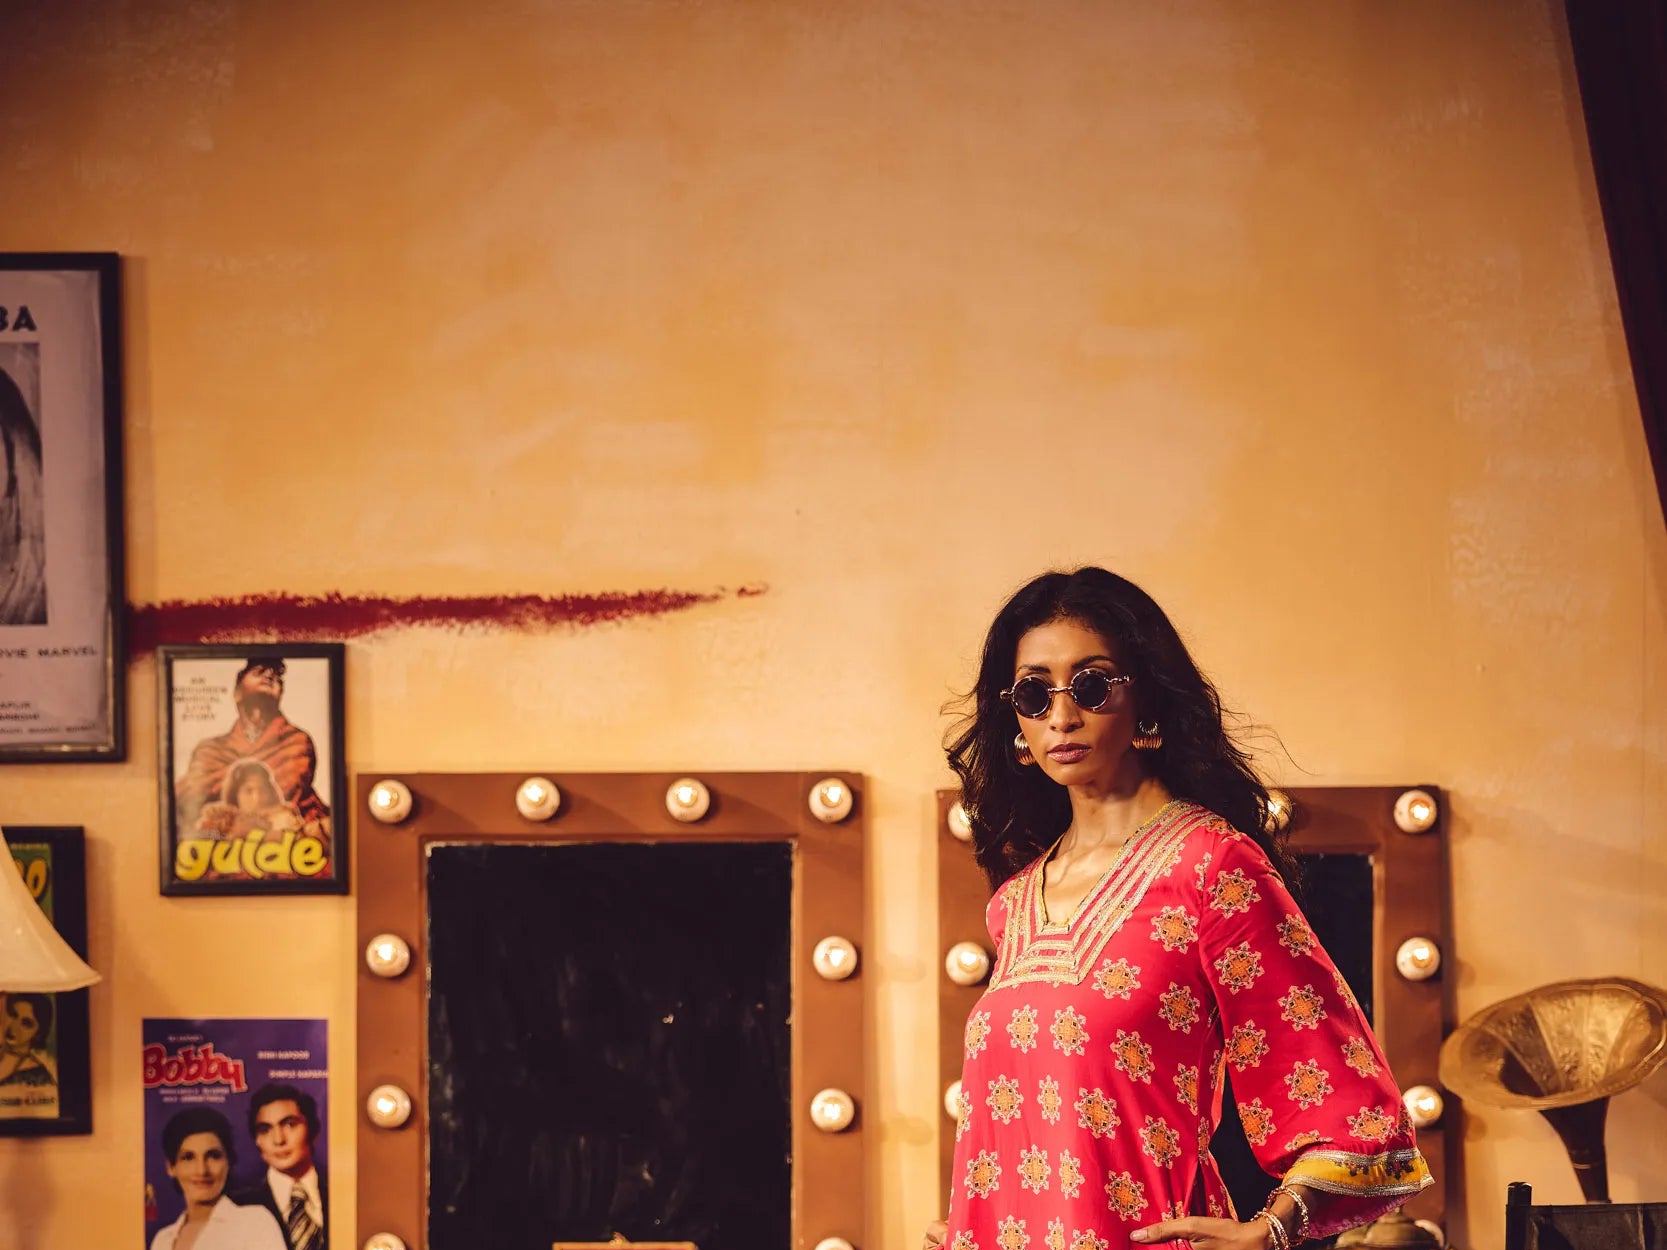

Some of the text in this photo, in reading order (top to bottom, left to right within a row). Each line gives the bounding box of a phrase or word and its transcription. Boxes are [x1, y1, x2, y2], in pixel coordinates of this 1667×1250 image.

[38, 646, 97, 657] MARVEL
[175, 829, 328, 881] guide
[142, 1042, 248, 1093] Bobby
